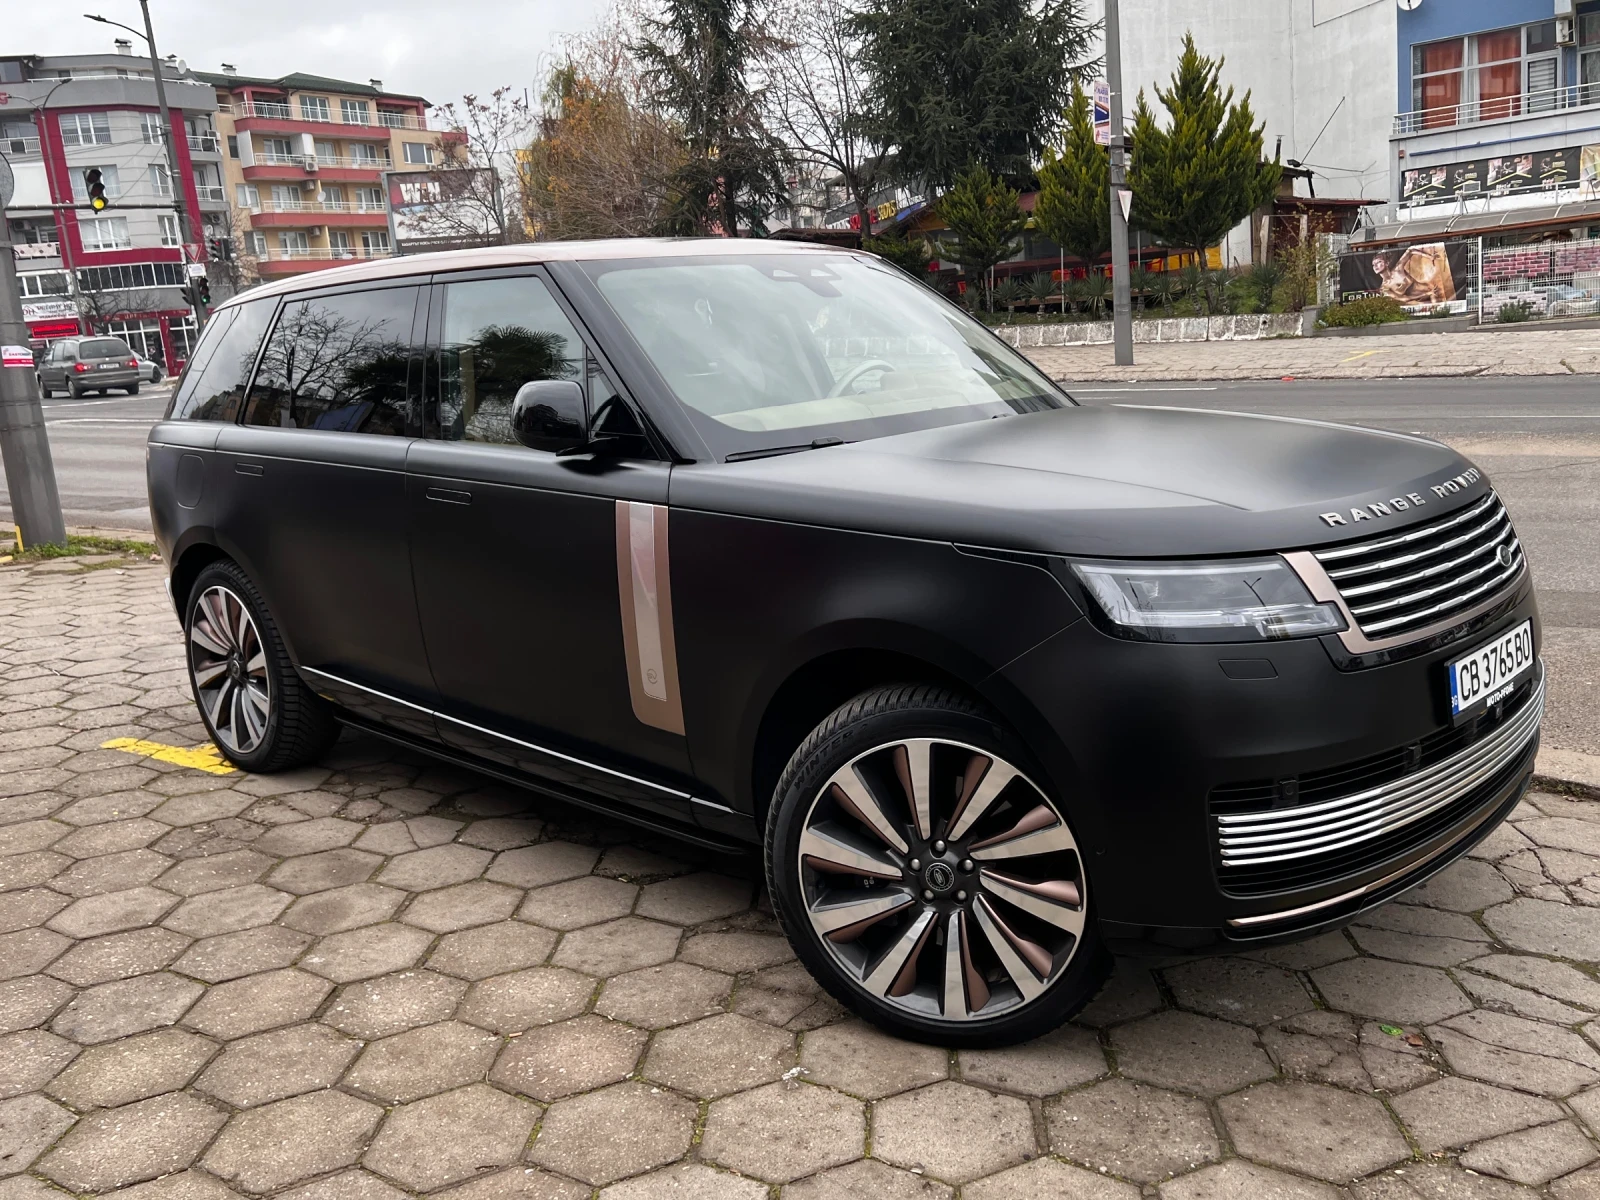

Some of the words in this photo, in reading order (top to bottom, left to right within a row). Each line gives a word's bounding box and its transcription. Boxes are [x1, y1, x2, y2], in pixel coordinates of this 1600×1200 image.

[1319, 492, 1426, 527] RANGE
[1430, 467, 1481, 499] ROVER
[1459, 658, 1481, 702] CB
[1482, 637, 1514, 689] 3765
